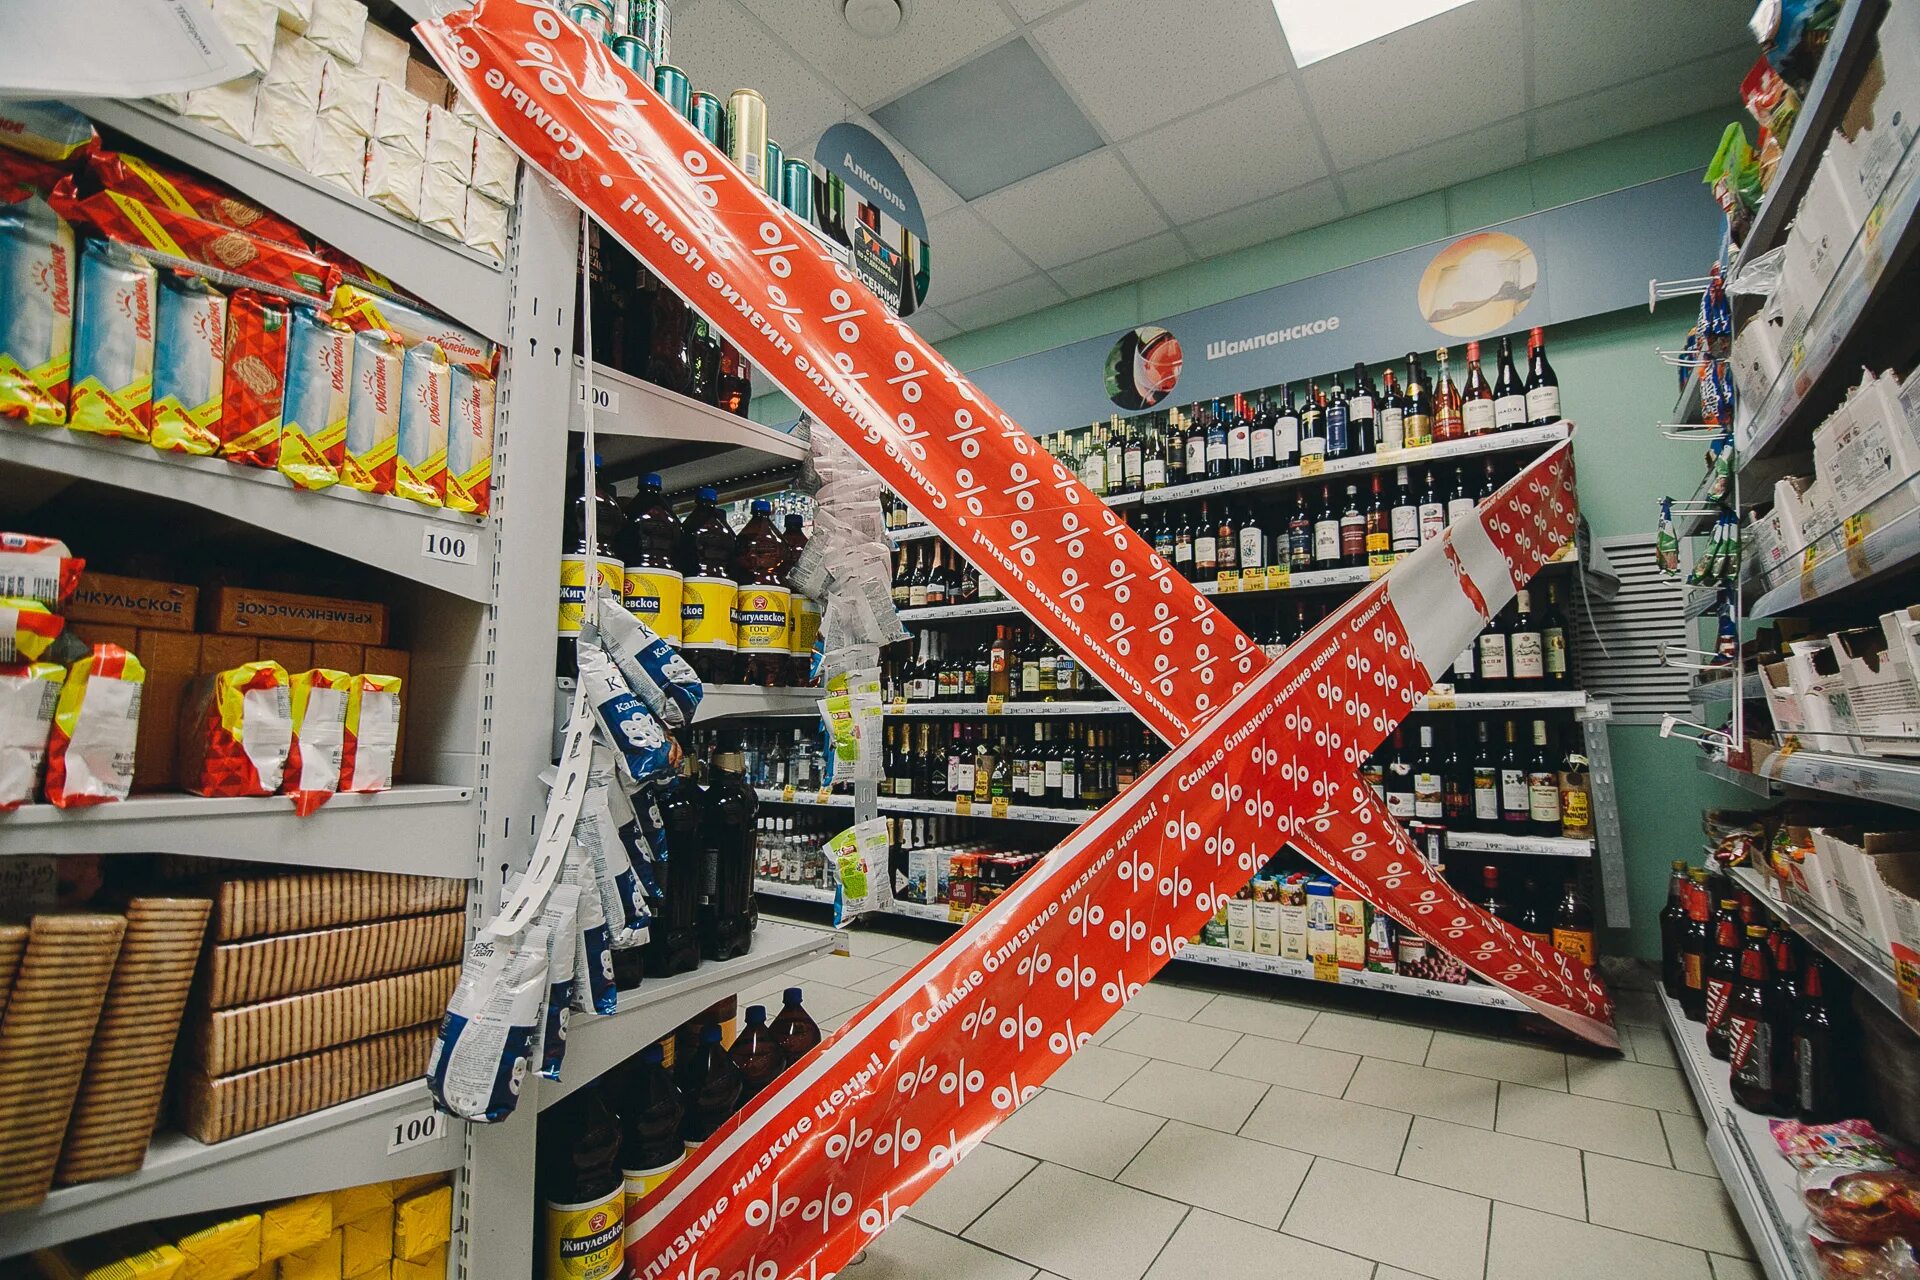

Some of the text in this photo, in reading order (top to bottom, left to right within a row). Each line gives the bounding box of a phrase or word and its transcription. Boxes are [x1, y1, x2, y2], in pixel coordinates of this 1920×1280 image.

[484, 68, 584, 161] Самые
[843, 152, 906, 212] Алкоголь
[619, 194, 705, 272] цены!
[707, 271, 793, 357] низкие
[1205, 313, 1341, 361] Шампанское
[375, 355, 388, 415] Юбилейное
[429, 370, 441, 427] Юбилейное
[472, 385, 482, 438] Юбилейное
[794, 355, 882, 445] близкие
[884, 442, 947, 510] Самые
[426, 533, 466, 558] 100
[972, 529, 1023, 582] цены!
[236, 601, 372, 624] КРЕМЕНКУЛЬСКОЕ
[1026, 579, 1080, 637] низкие
[1083, 633, 1143, 696] близкие
[1145, 690, 1191, 738] Самые
[731, 1115, 812, 1197] низкие
[814, 1051, 884, 1121] цены!
[911, 969, 984, 1033] Самые
[982, 901, 1059, 973] близкие
[1061, 847, 1115, 904] низкие
[1116, 801, 1158, 852] цены!
[1178, 747, 1225, 792] Самые
[1223, 702, 1274, 752] близкие
[1274, 667, 1312, 707] низкие
[1310, 637, 1341, 672] цены!
[1351, 601, 1382, 633] Самые
[1337, 860, 1373, 897] Самые
[392, 1115, 435, 1146] 100
[562, 1221, 623, 1253] Жигулевское
[584, 1248, 611, 1265] ГОСТ
